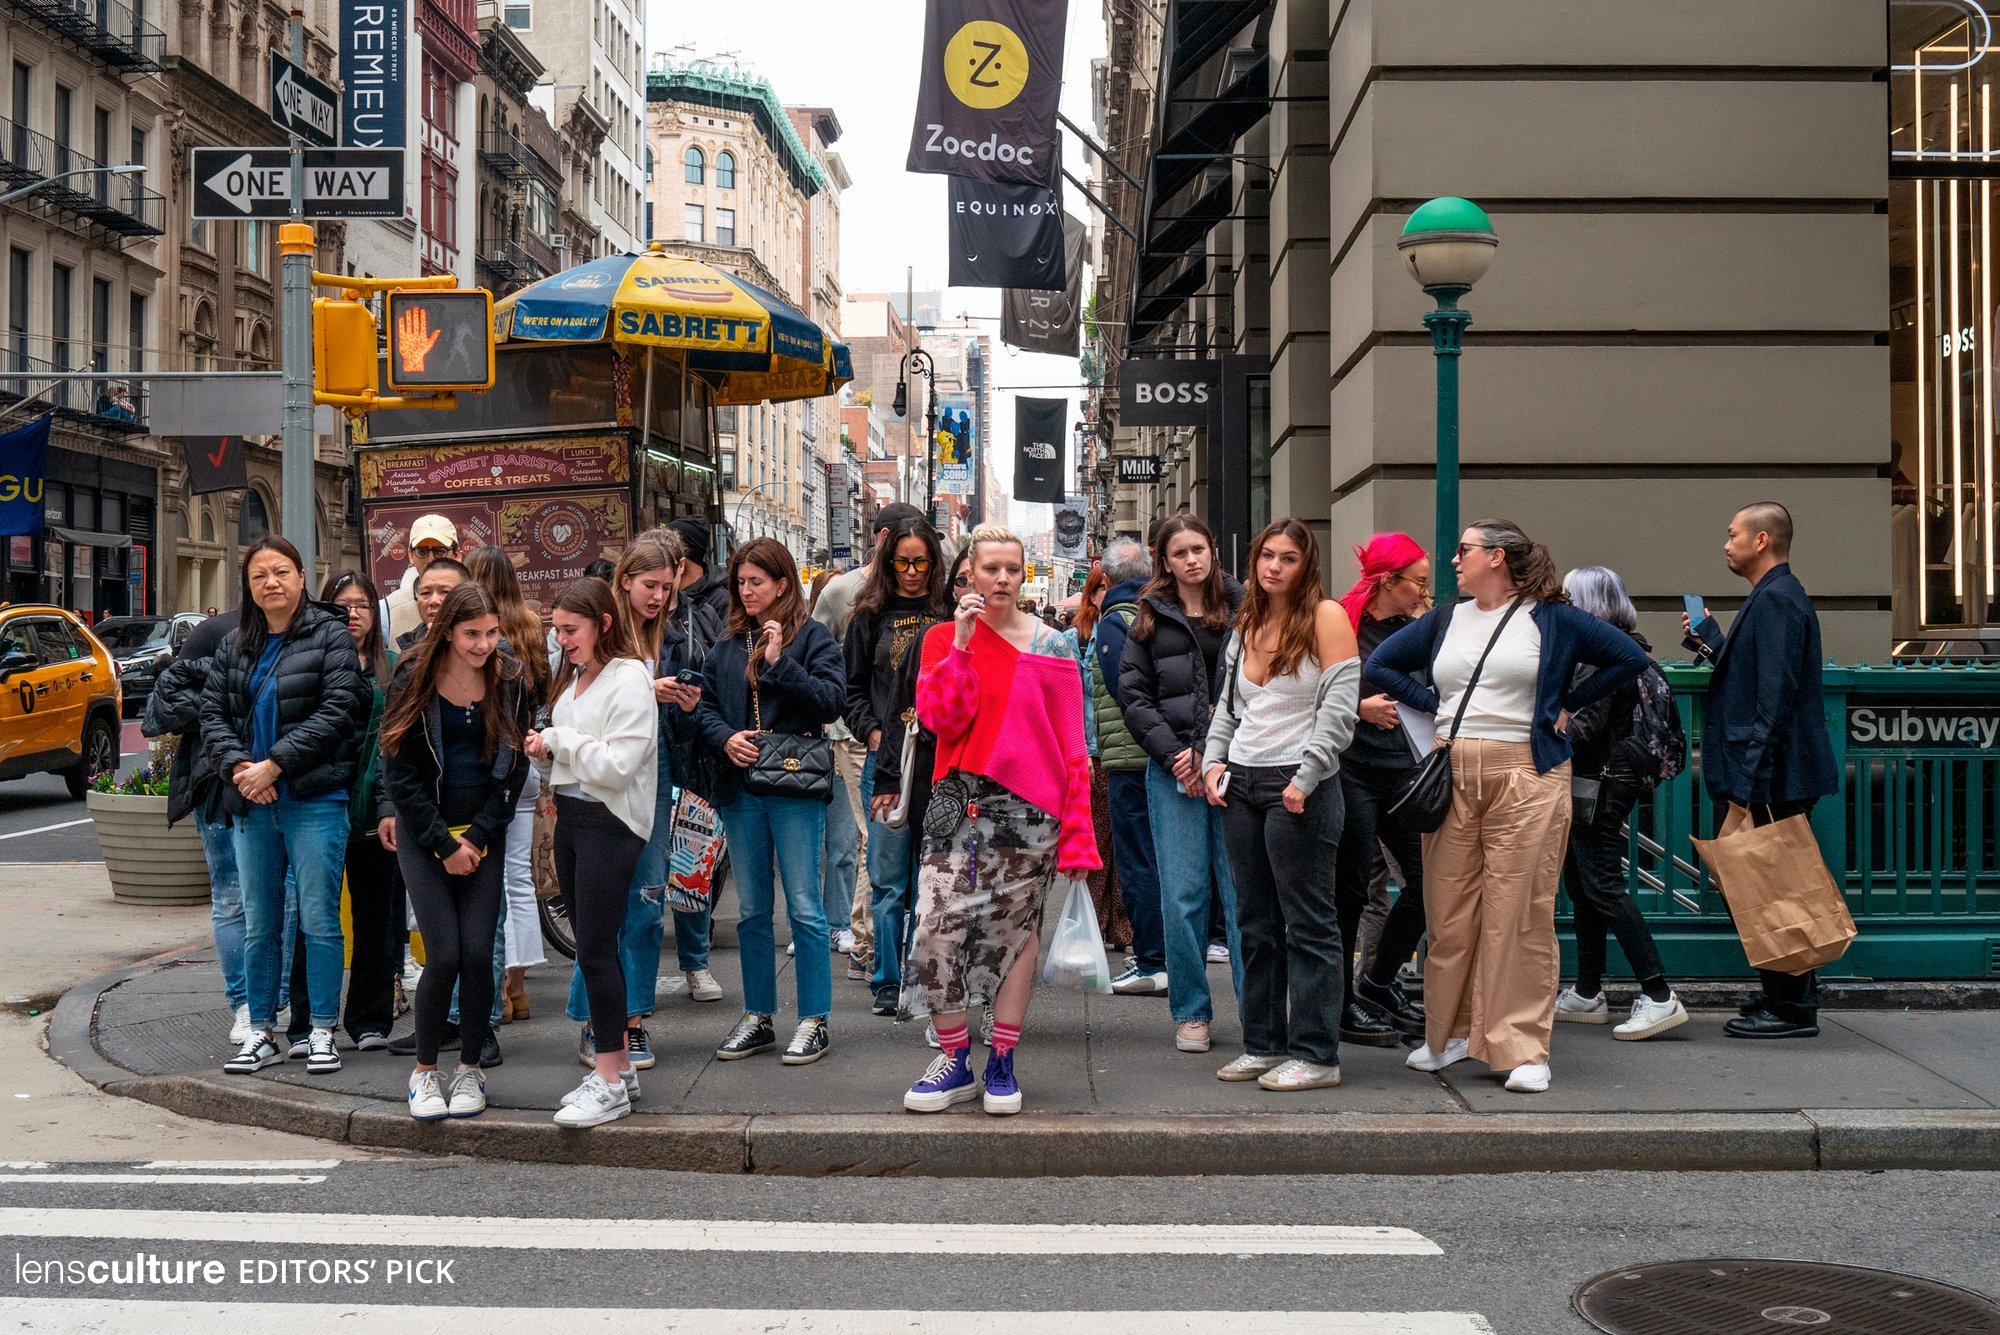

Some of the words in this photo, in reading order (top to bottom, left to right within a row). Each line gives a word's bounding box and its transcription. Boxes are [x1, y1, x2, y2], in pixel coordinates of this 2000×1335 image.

[391, 8, 398, 18] 65
[283, 81, 302, 115] ONE
[311, 97, 331, 131] WAY
[926, 124, 1033, 166] Zocdoc
[226, 171, 284, 197] ONE
[314, 171, 376, 197] WAY
[956, 201, 1056, 217] EQUINOX
[634, 276, 721, 289] SABRETT
[523, 316, 548, 326] WE'RE
[551, 317, 562, 326] ON
[563, 317, 569, 326] A
[570, 316, 587, 327] ROLL
[589, 317, 599, 326] !!!
[618, 310, 763, 343] SABRETT
[1135, 382, 1208, 404] BOSS
[571, 449, 594, 457] LUNCH
[387, 459, 425, 469] BREAKFAST
[428, 456, 490, 484] SWEET
[493, 454, 567, 476] BARISTA
[570, 467, 604, 476] European
[1122, 459, 1156, 475] Milk
[385, 478, 426, 487] Handmade
[444, 477, 492, 489] COFFEE
[494, 476, 503, 485] &
[505, 474, 551, 485] TREATS
[572, 475, 603, 483] Pastries
[943, 470, 968, 481] SOHO
[0, 474, 43, 503] GU
[393, 487, 419, 495] Bagels
[541, 505, 560, 517] DECAF
[375, 520, 394, 544] CHICKEN
[470, 516, 493, 535] CHICKEN
[533, 521, 541, 543] COFFEE
[541, 550, 552, 560] TEA
[562, 550, 582, 562] HERBAL
[581, 540, 589, 552] TEA
[516, 569, 560, 582] REAKFAST
[22, 687, 31, 710] T
[1851, 708, 2000, 749] Subway
